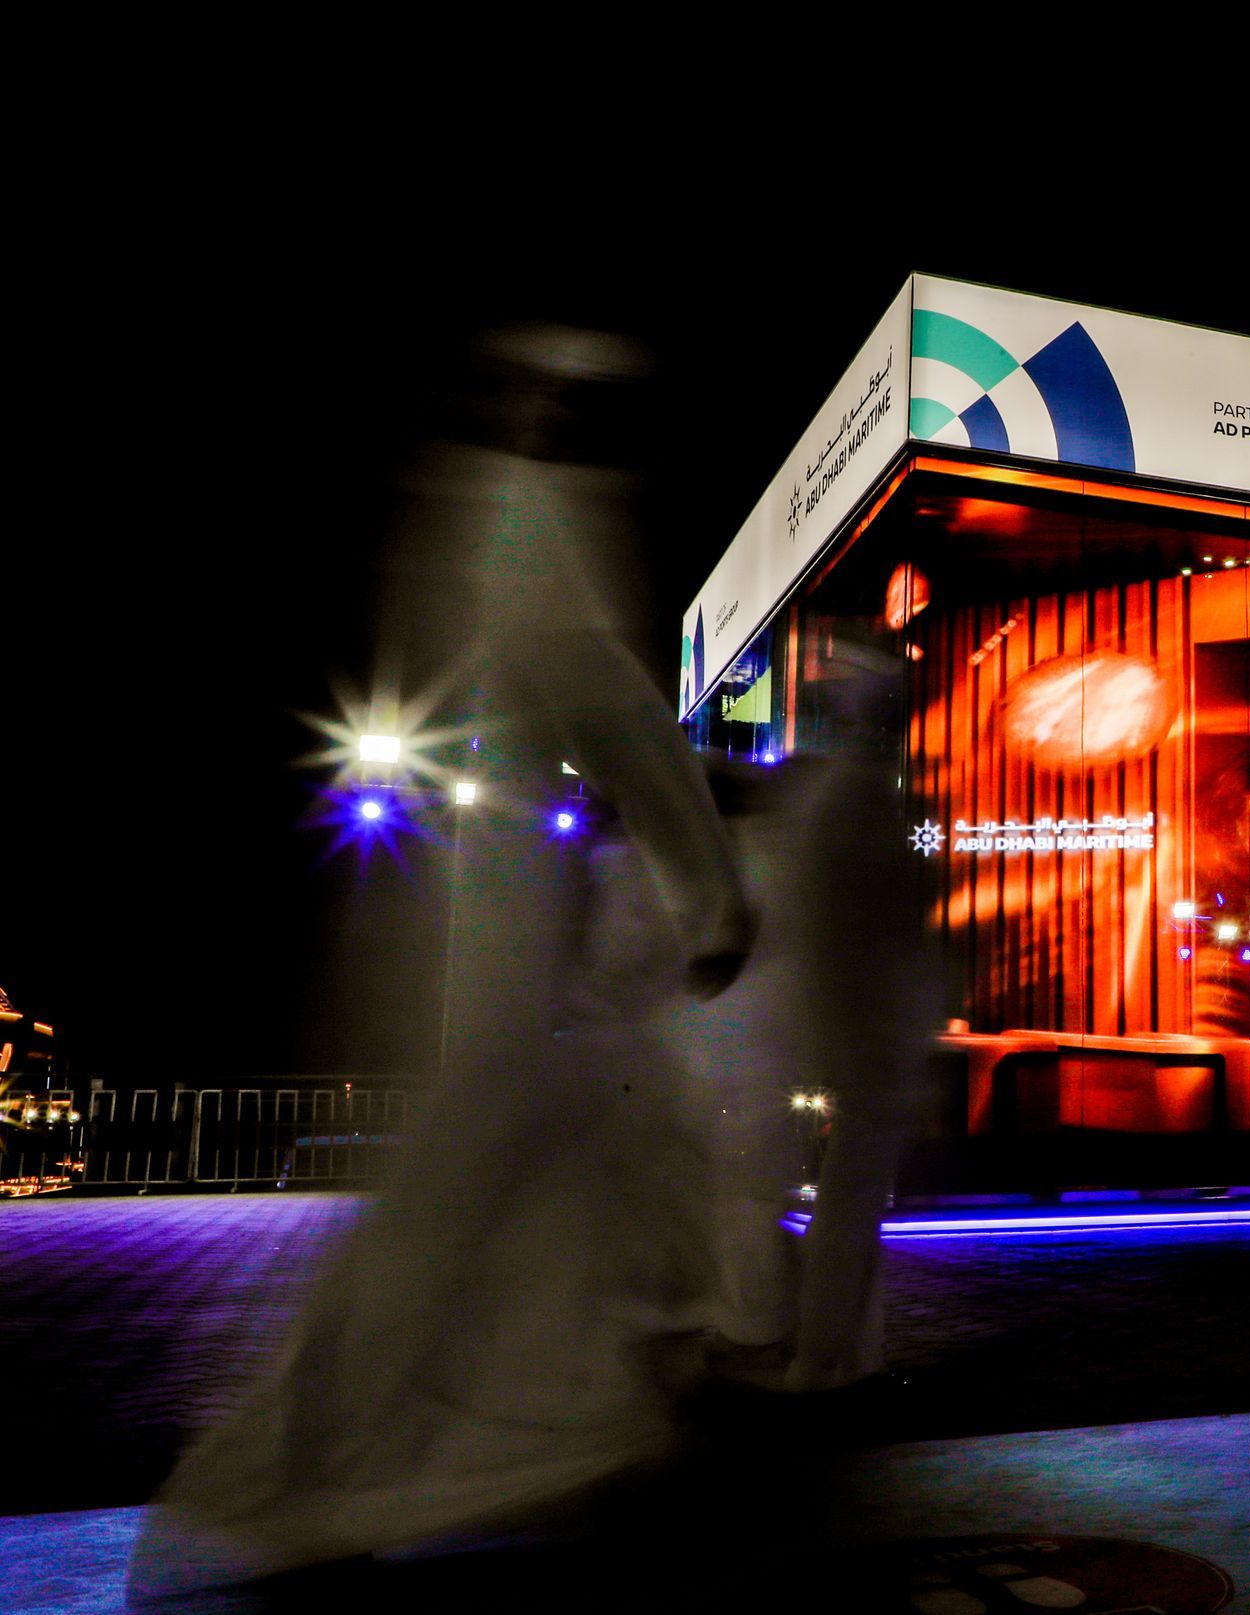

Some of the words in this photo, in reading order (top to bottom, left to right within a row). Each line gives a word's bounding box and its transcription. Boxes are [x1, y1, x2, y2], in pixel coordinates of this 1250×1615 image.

[1213, 421, 1238, 437] AD
[805, 482, 821, 518] ABU
[822, 446, 847, 495] DHABI
[848, 386, 891, 461] MARITIME
[954, 838, 993, 852] ABU
[995, 837, 1055, 851] DHABI
[1057, 834, 1154, 850] MARITIME
